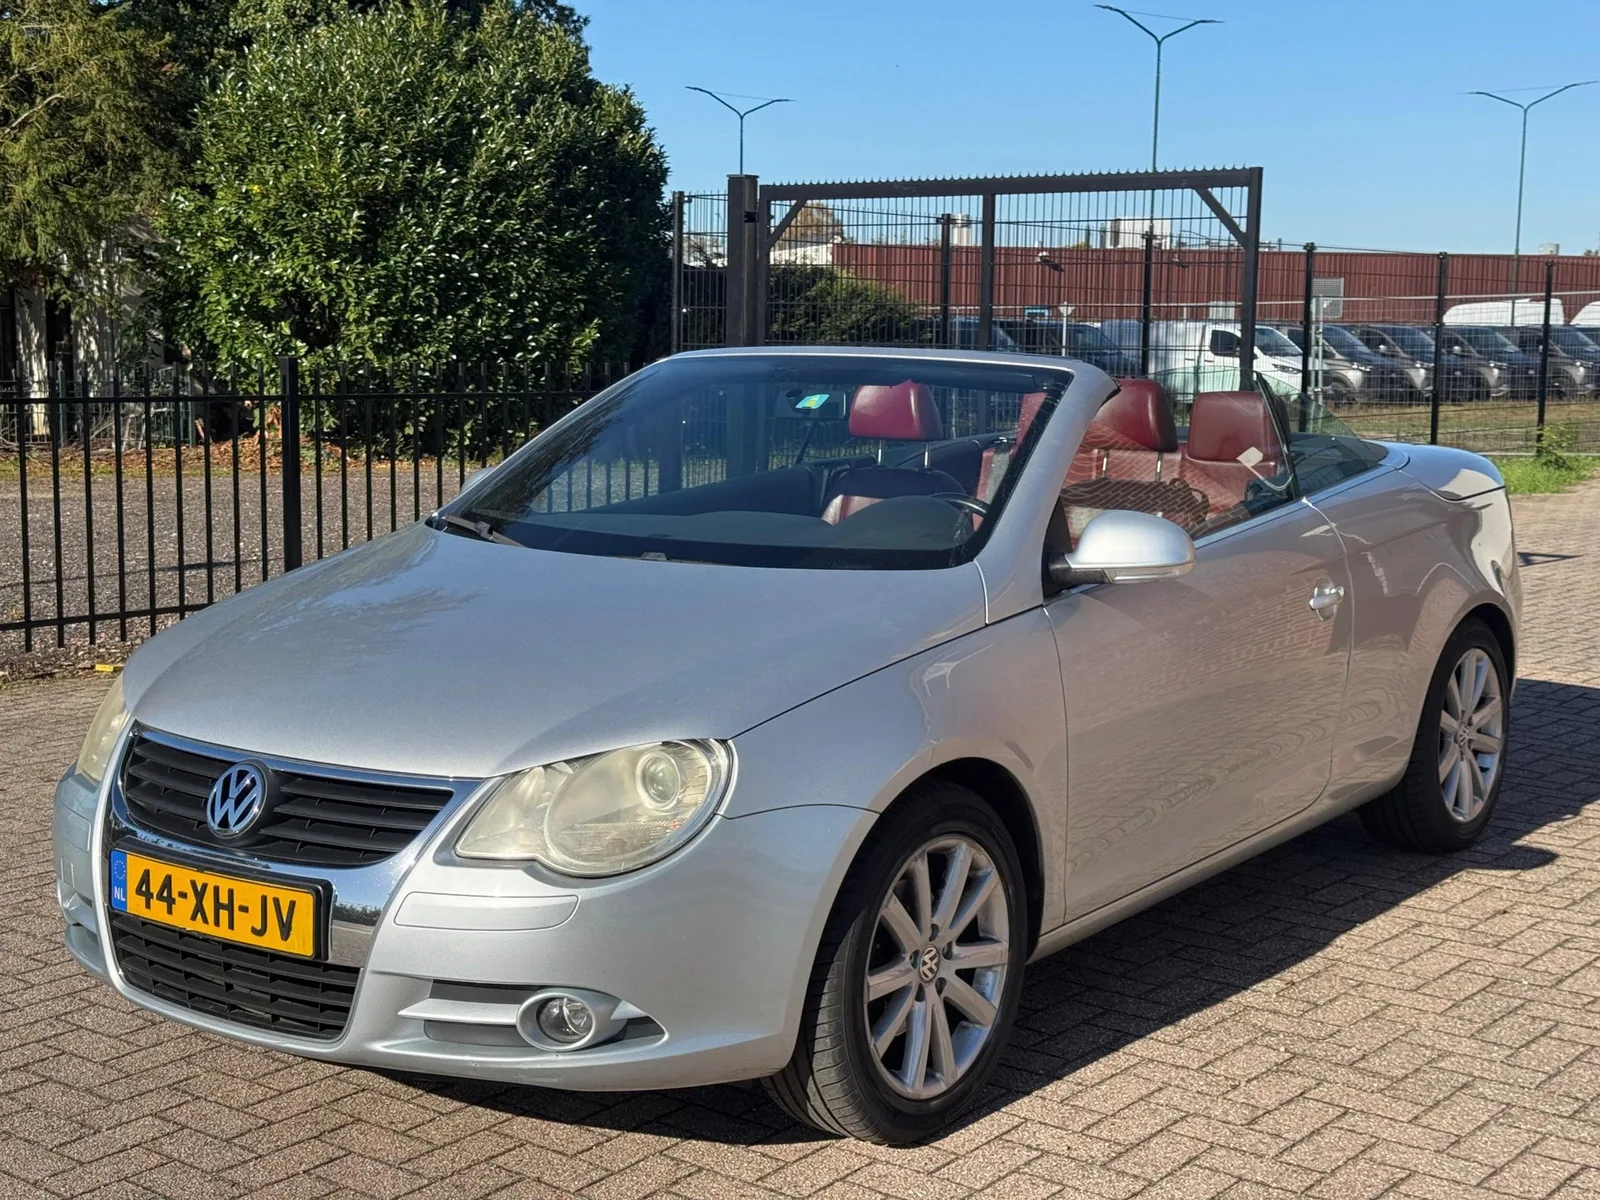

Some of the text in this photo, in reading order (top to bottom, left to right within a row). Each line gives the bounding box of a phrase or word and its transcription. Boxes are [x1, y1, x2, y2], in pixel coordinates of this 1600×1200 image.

[207, 764, 262, 833] VW
[113, 886, 126, 902] NL
[135, 868, 297, 942] 44-XH-JV
